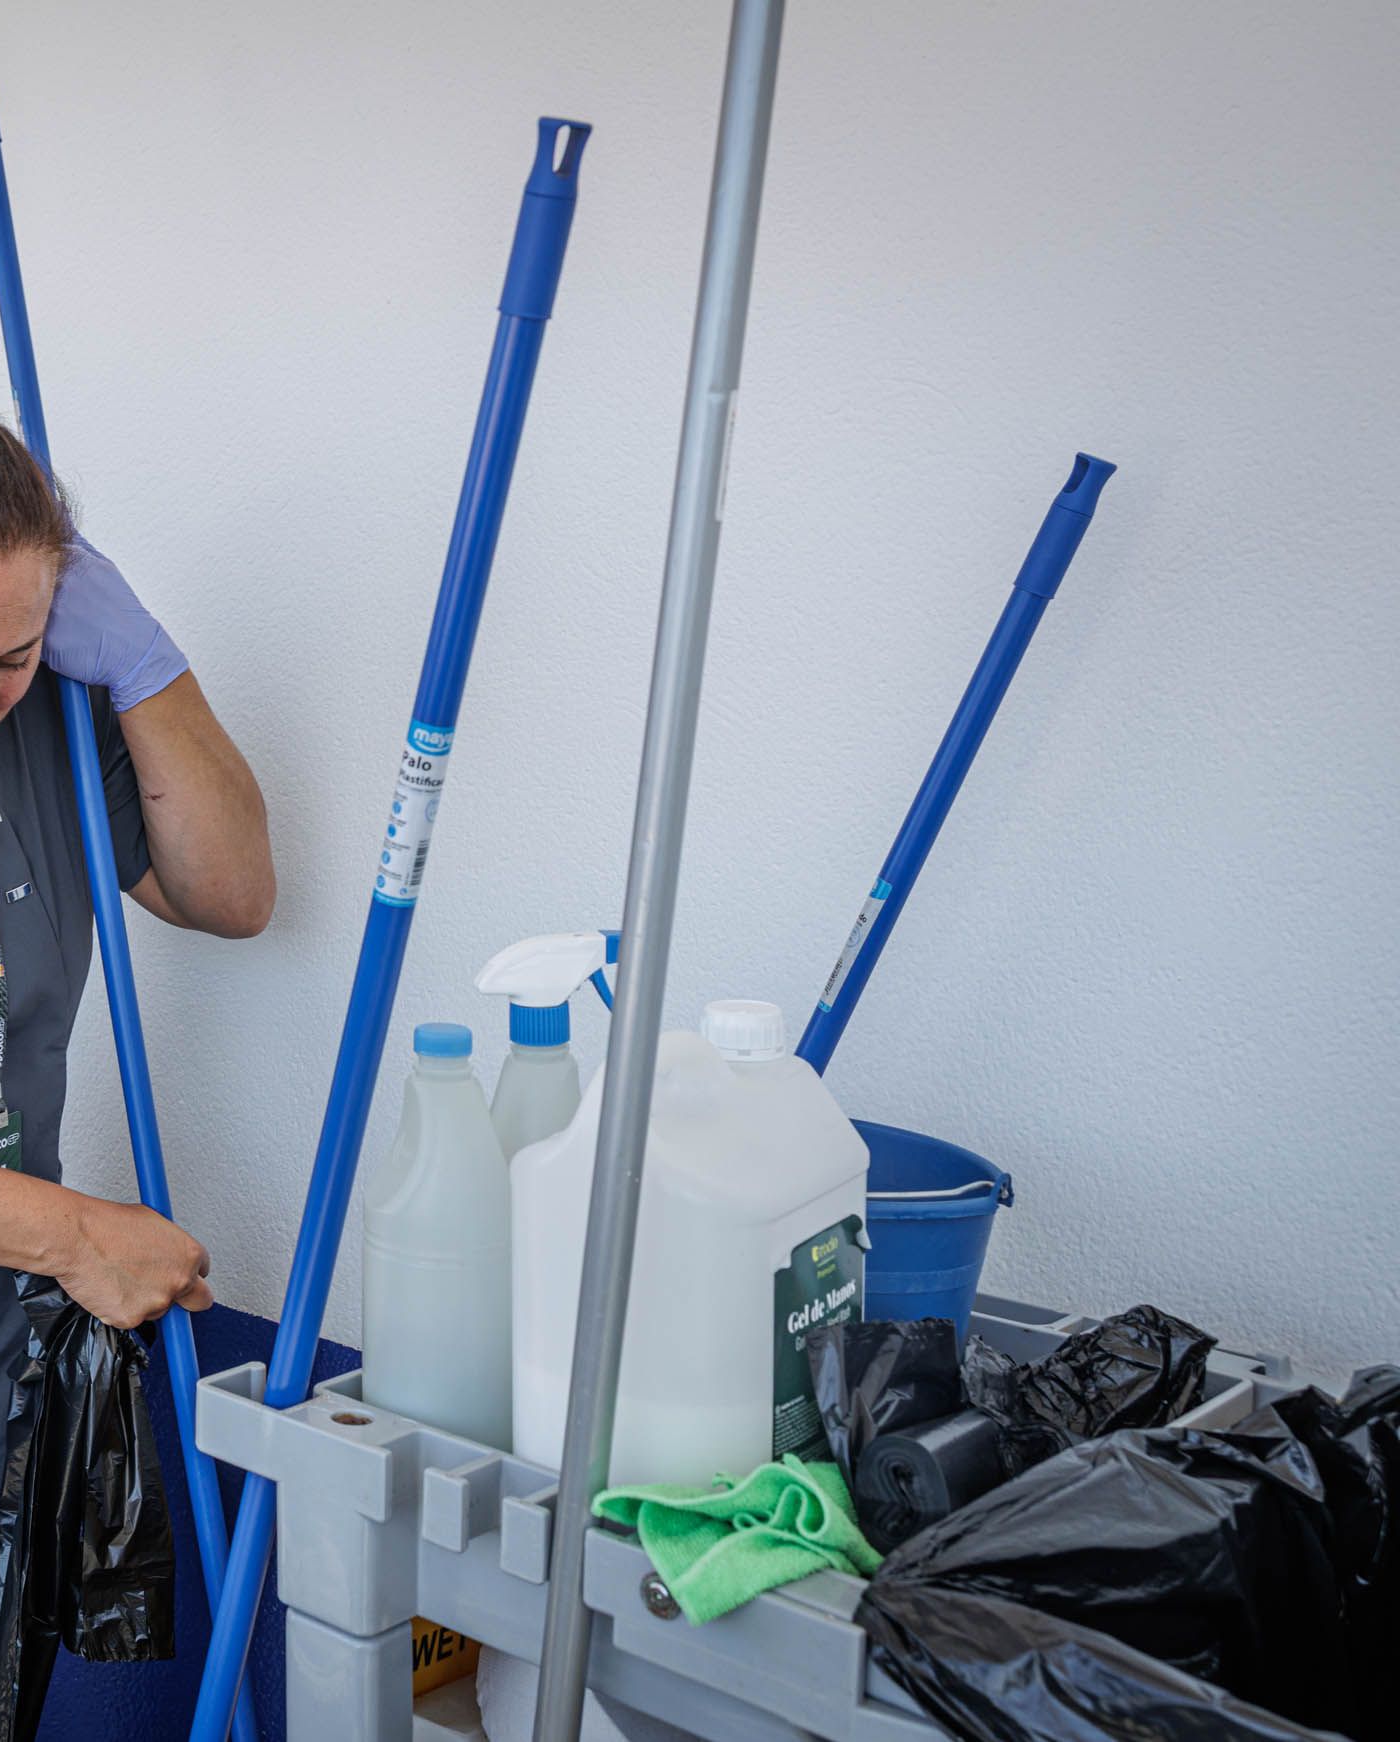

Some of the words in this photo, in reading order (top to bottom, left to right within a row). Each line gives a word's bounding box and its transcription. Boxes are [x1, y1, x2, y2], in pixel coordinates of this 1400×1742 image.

[402, 750, 432, 772] Palo
[787, 1303, 809, 1334] Gel
[810, 1298, 825, 1322] de
[826, 1279, 856, 1313] Manos
